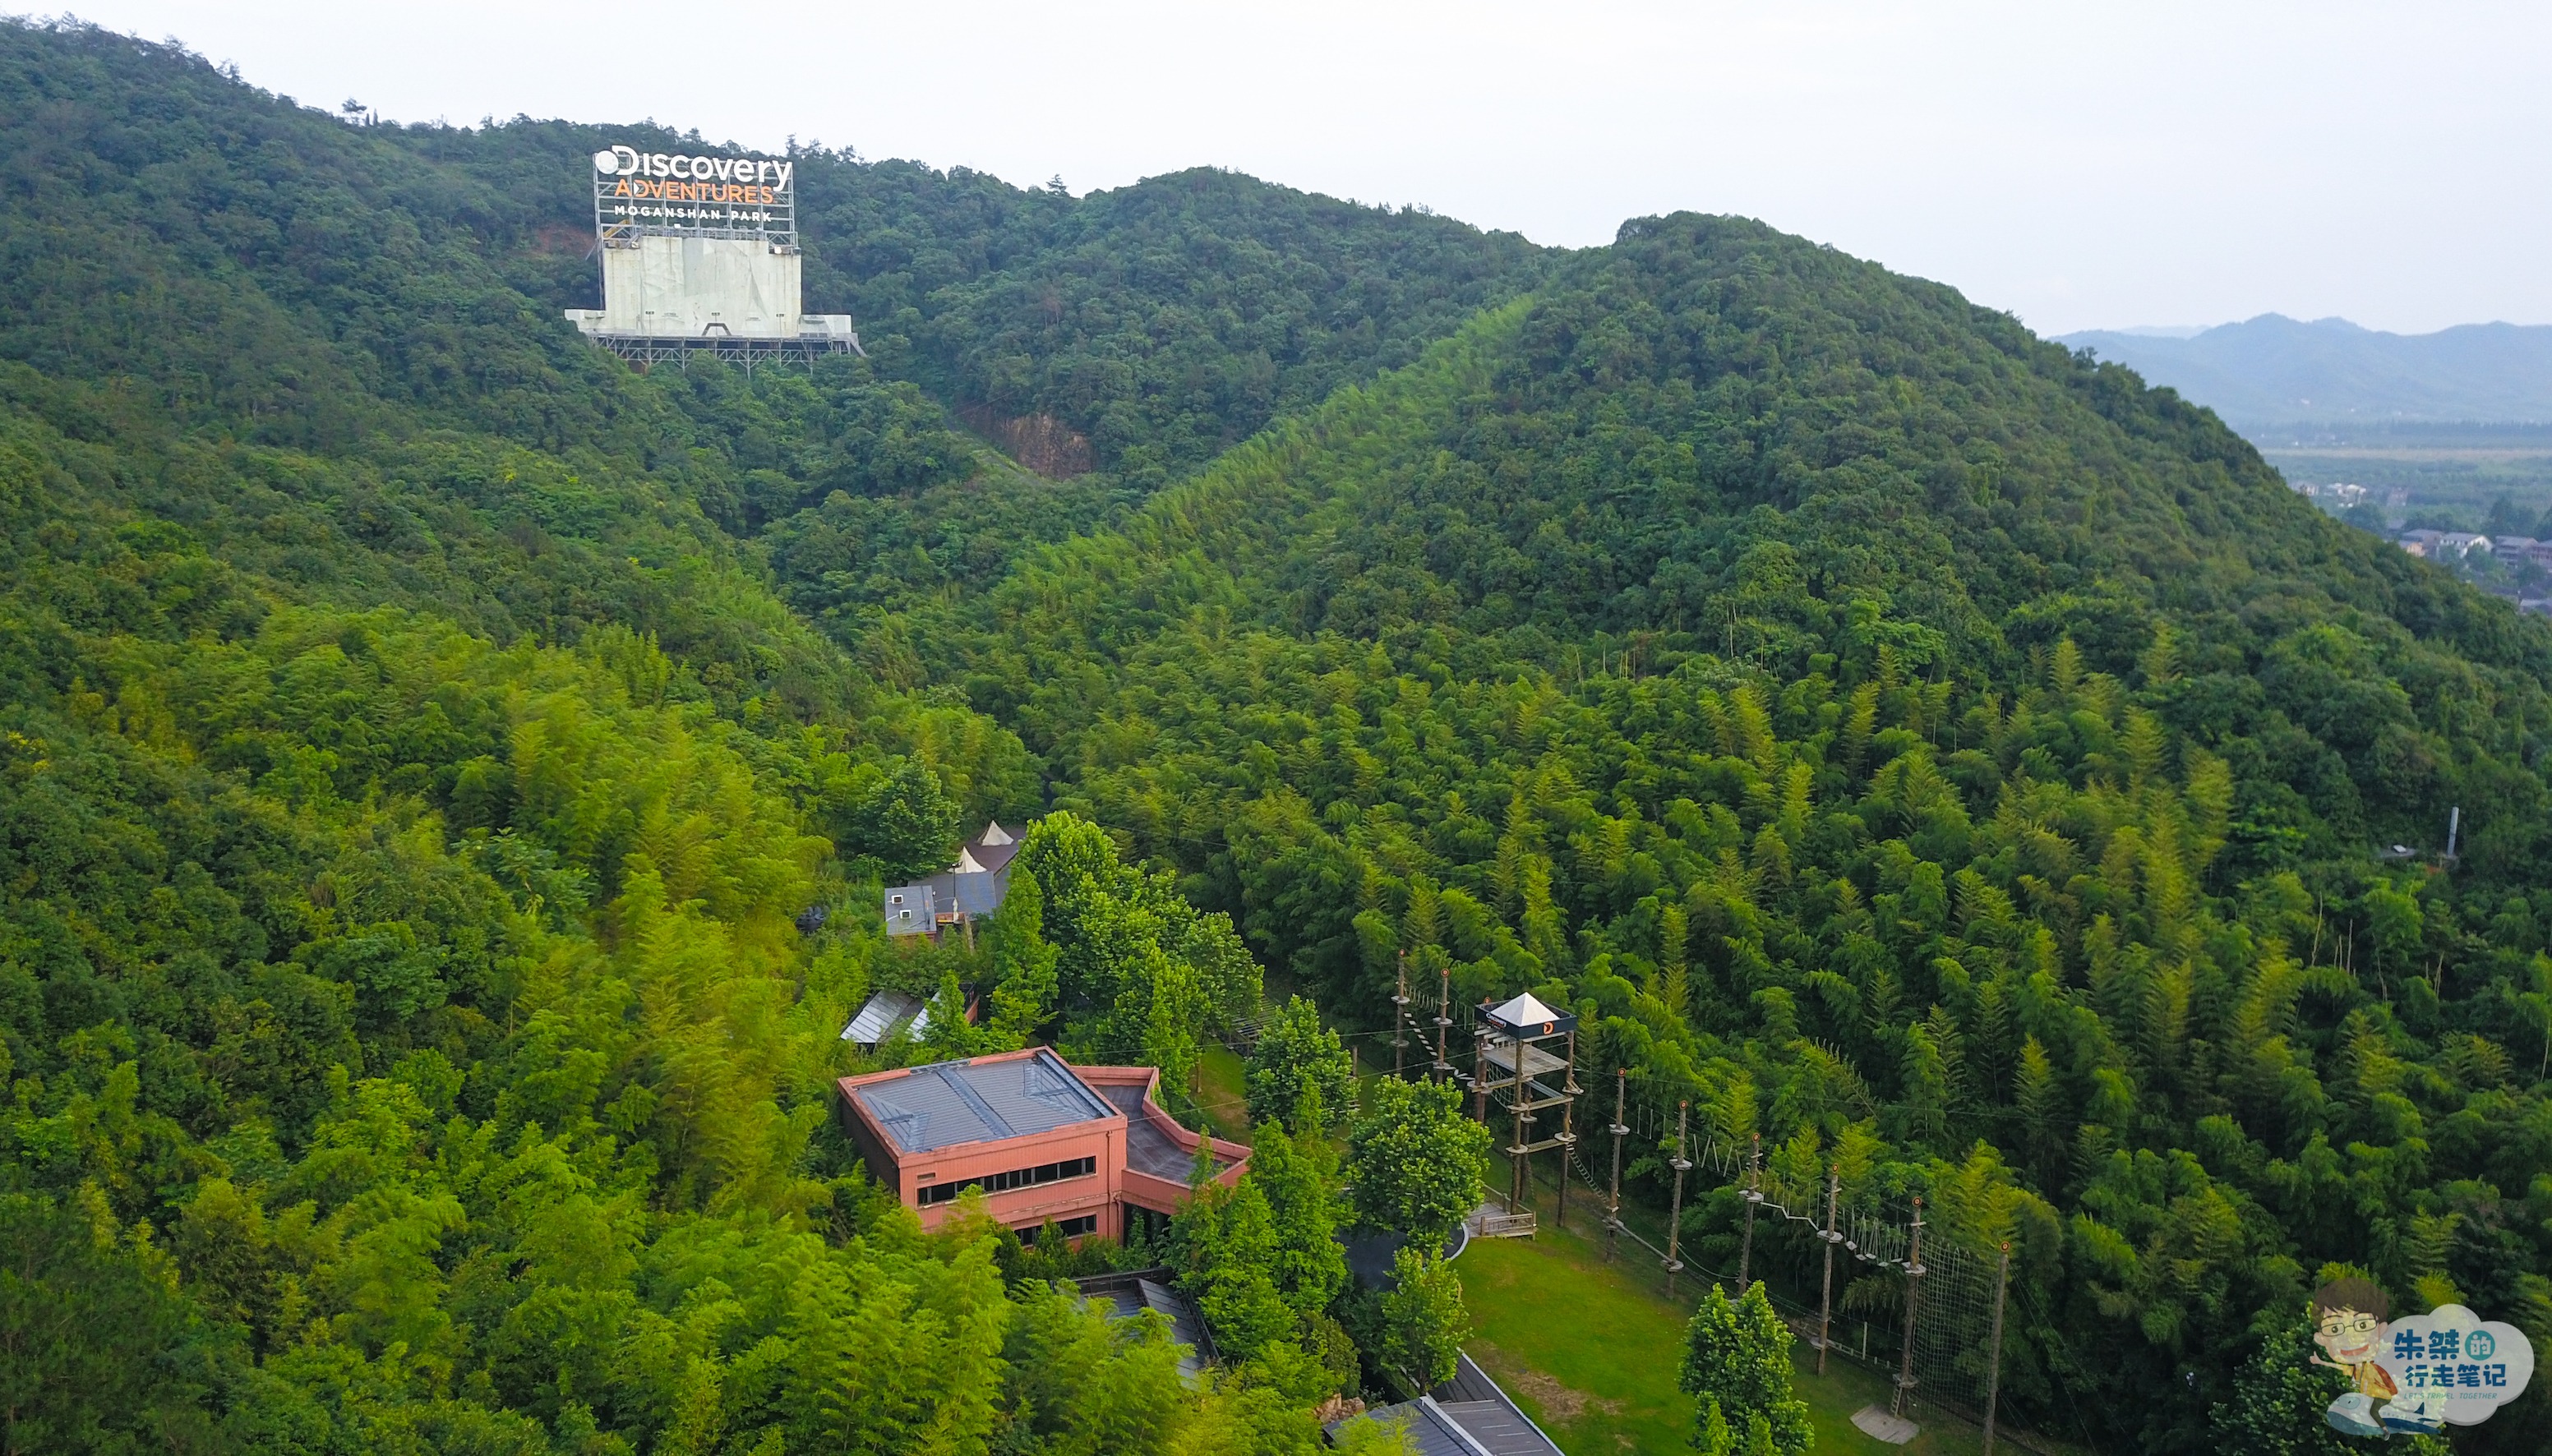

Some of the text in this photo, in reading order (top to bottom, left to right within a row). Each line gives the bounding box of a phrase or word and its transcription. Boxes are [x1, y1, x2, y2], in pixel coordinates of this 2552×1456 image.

[595, 145, 792, 192] Discovery
[614, 178, 774, 205] ADVENTURES
[615, 205, 772, 223] MOGANSHAN PARK
